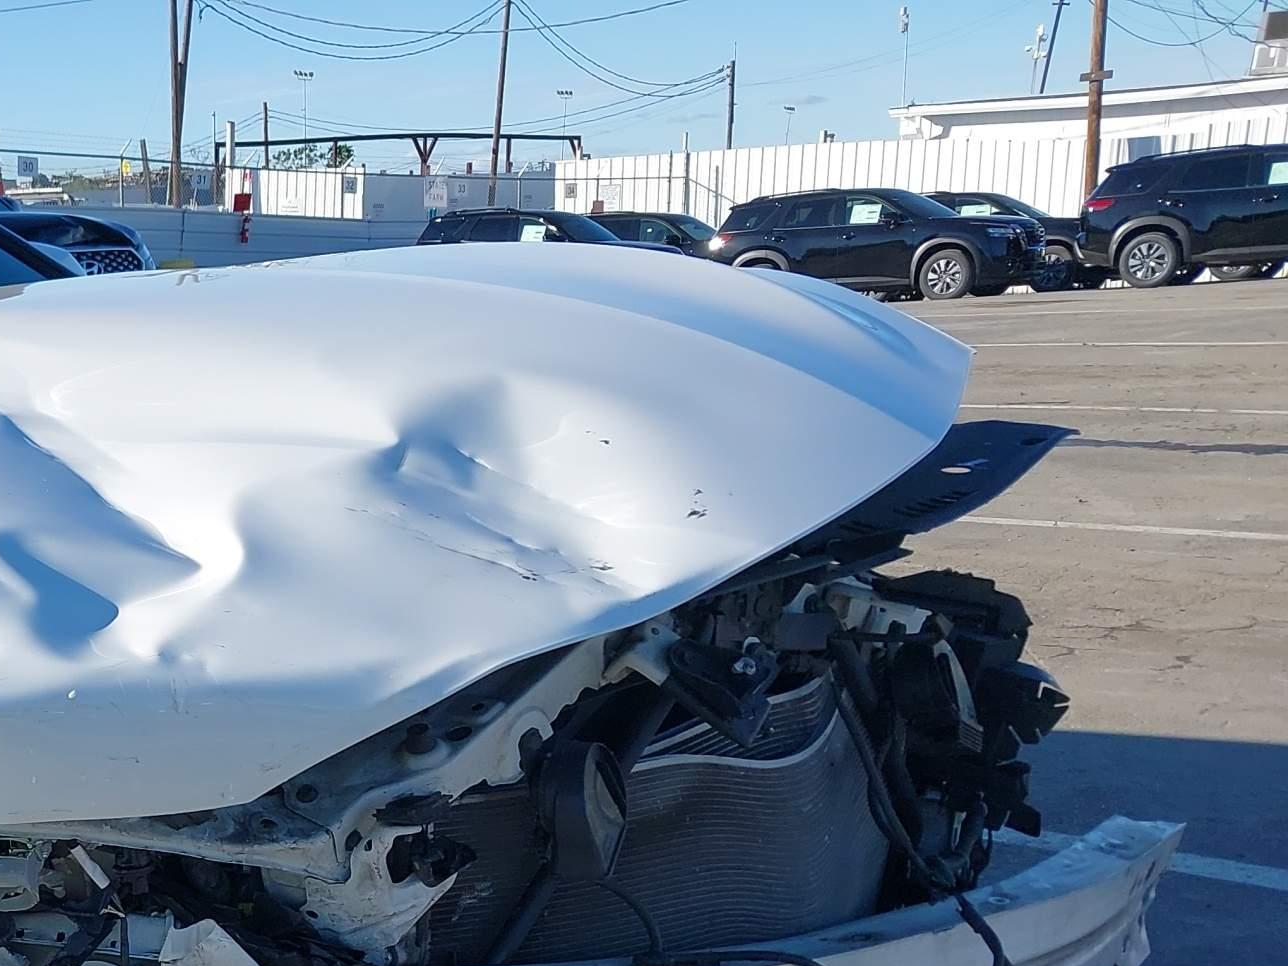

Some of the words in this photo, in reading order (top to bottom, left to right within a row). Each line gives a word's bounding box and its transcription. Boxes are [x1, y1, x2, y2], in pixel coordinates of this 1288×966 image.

[22, 161, 34, 172] 30
[196, 174, 207, 185] 31
[345, 180, 355, 190] 32
[457, 183, 467, 193] 33
